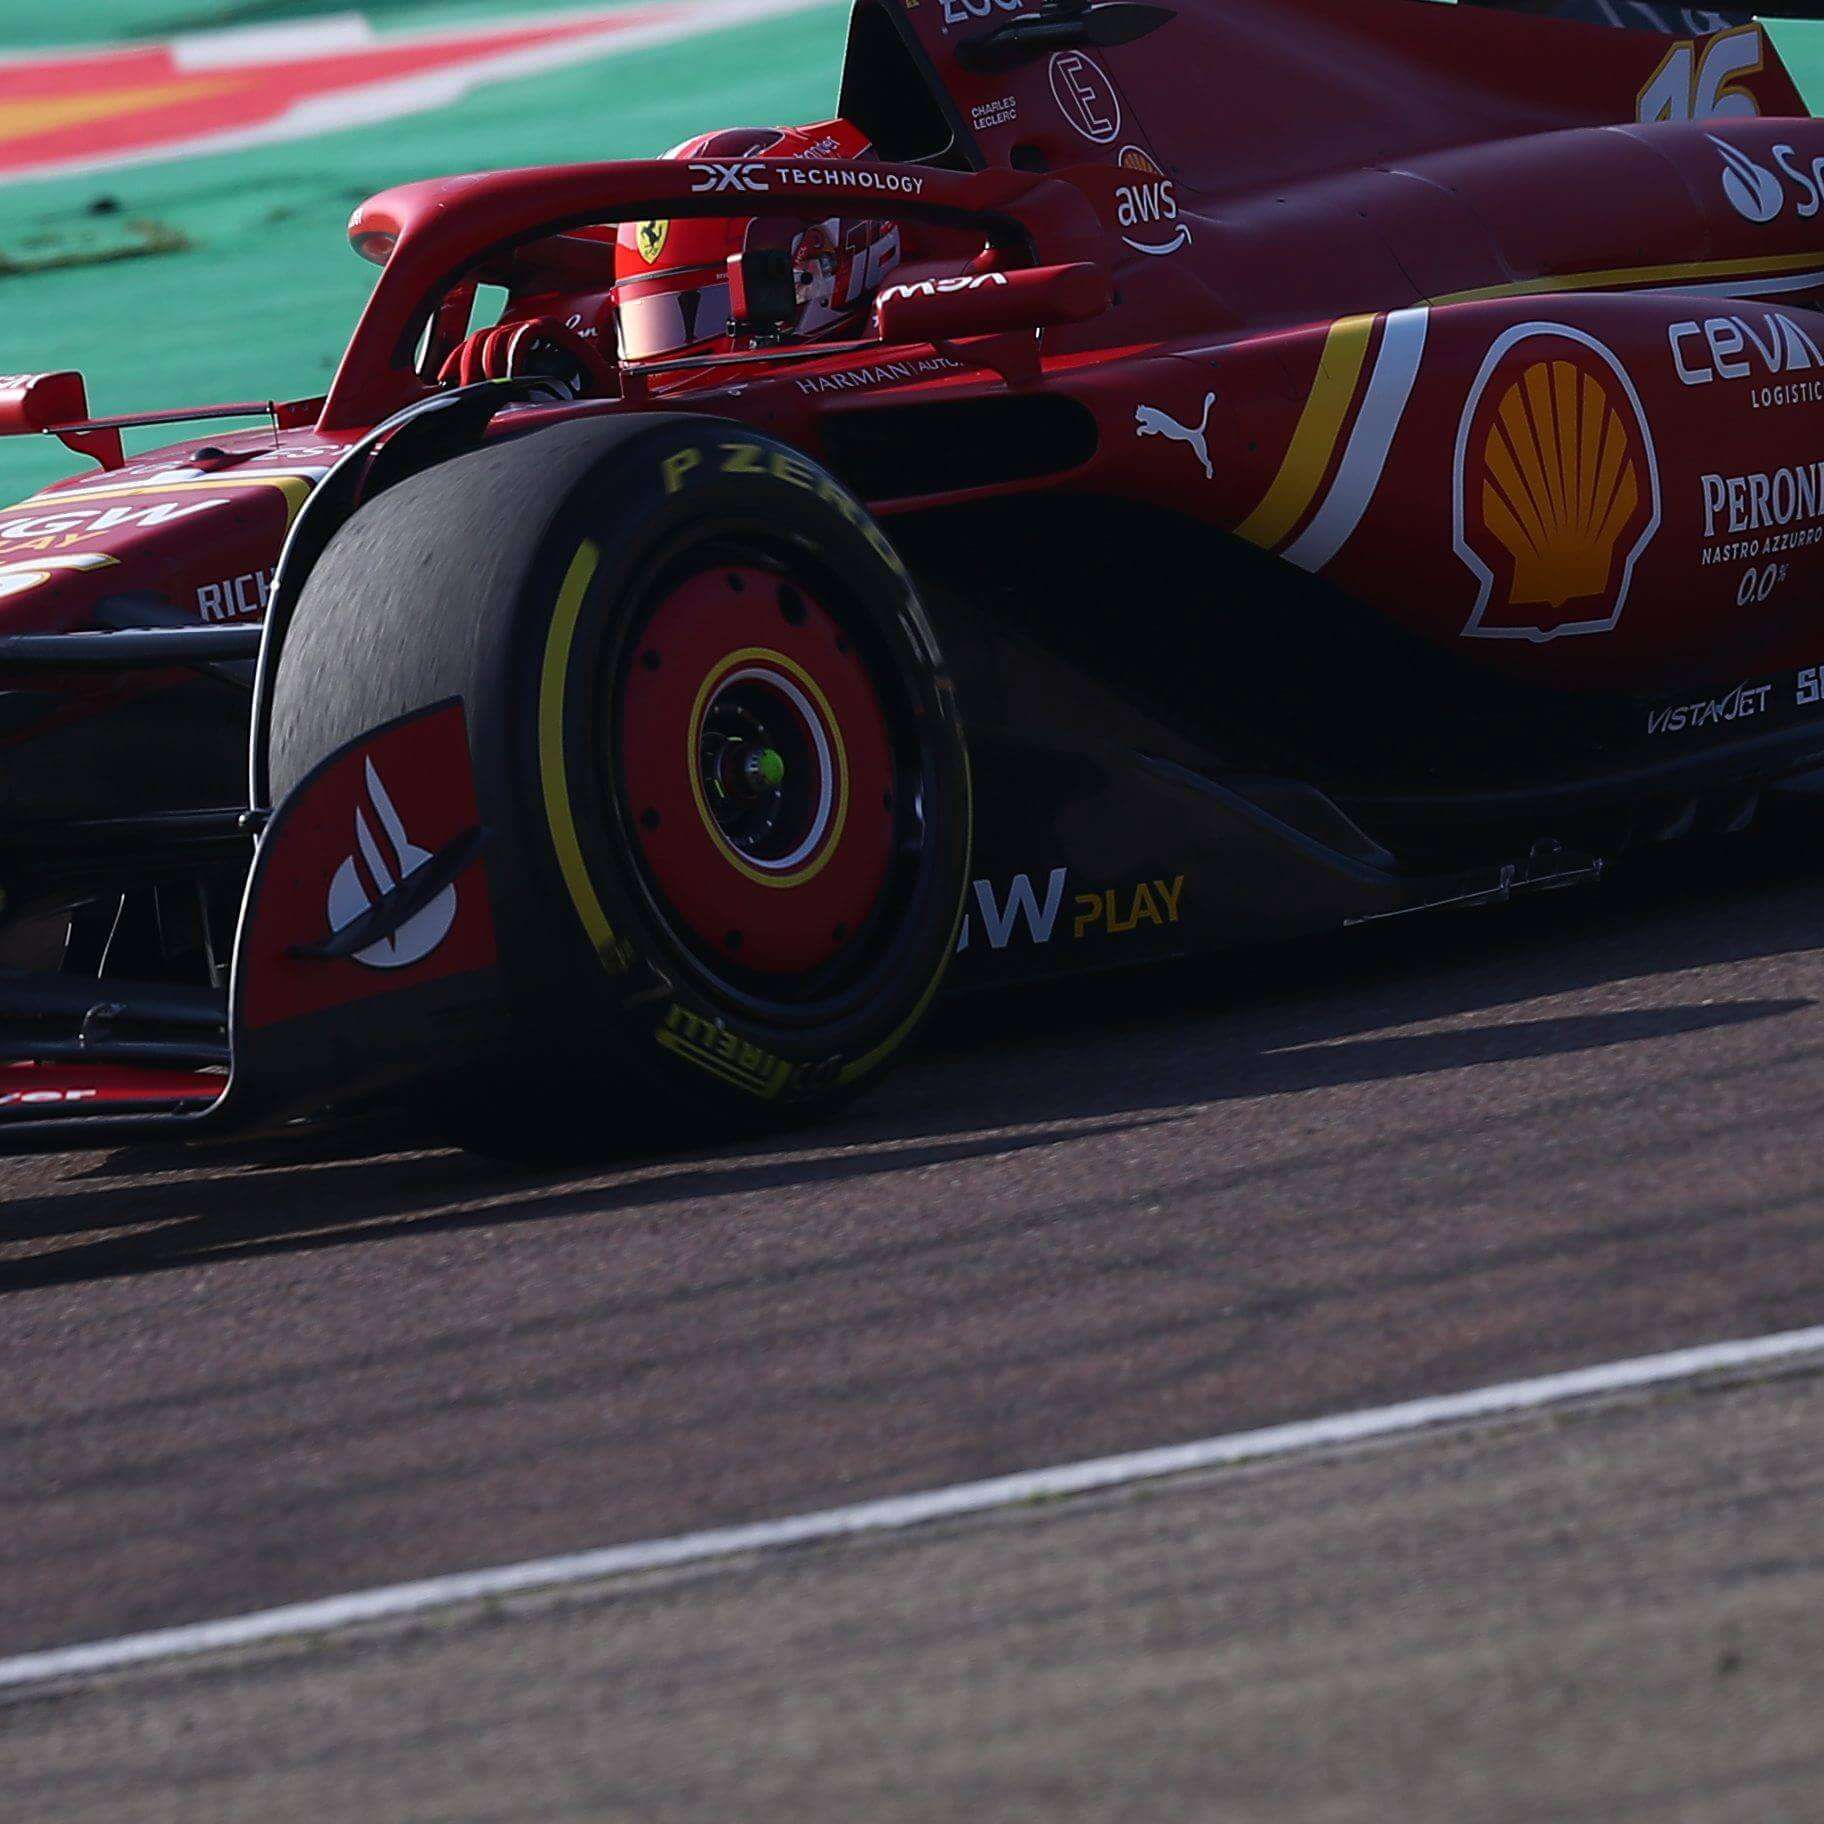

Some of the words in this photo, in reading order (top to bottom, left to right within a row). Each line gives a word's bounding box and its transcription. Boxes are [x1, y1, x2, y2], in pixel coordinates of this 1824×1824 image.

[971, 96, 1017, 119] CHARLES
[973, 109, 1017, 130] LECLERC
[688, 162, 770, 192] DXC
[776, 167, 924, 195] TECHNOLOGY
[1114, 179, 1178, 227] aws
[794, 362, 911, 395] HARMAN
[661, 446, 703, 495] P
[1701, 538, 1760, 566] NASTRO
[1761, 525, 1824, 555] AZZURRO
[956, 866, 1068, 954] W
[1073, 874, 1186, 939] PLAY
